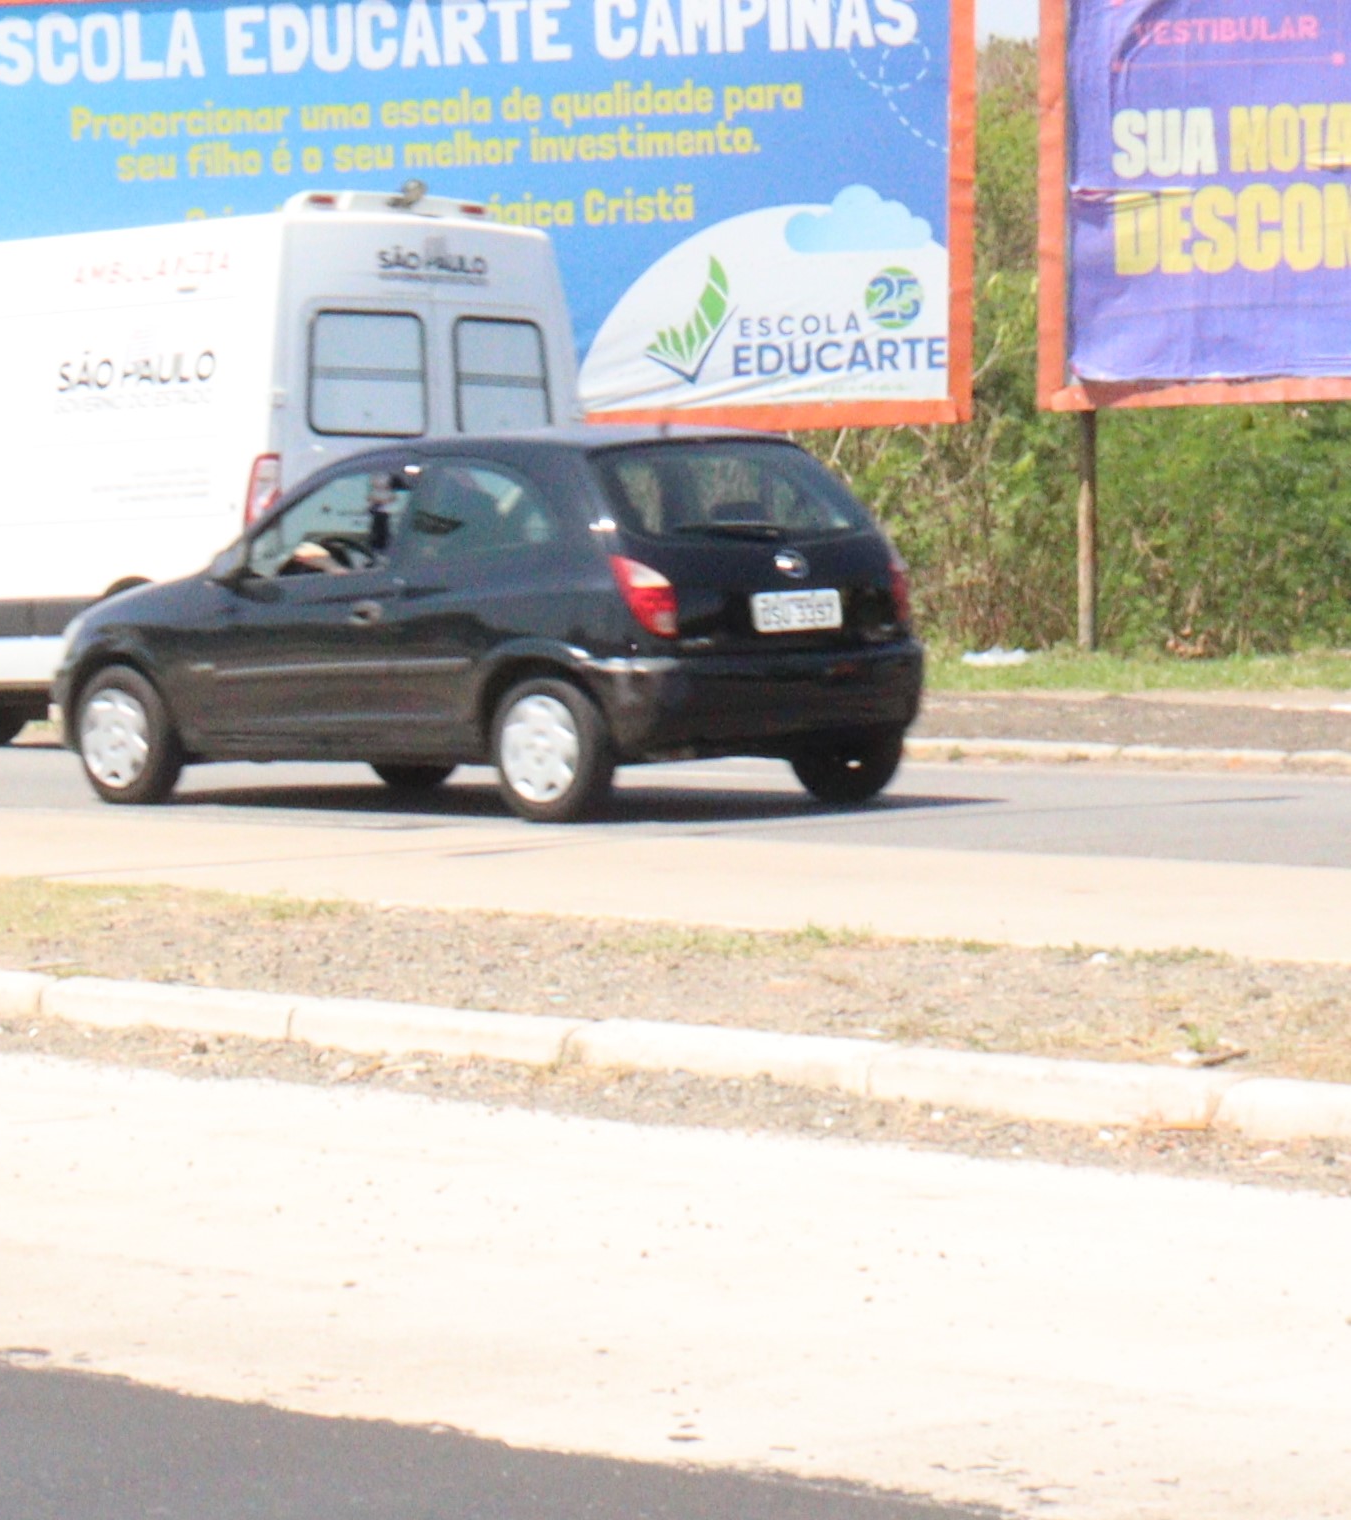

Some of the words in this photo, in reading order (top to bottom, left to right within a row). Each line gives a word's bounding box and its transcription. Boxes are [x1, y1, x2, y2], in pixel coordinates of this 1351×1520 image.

[225, 0, 572, 75] EDUCARTE
[594, 0, 919, 59] CAMPINAS
[71, 100, 291, 147] Proporcionar
[301, 103, 370, 130] uma
[381, 88, 492, 127] escola
[501, 86, 542, 121] de
[551, 80, 715, 127] qualidade
[724, 82, 803, 120] para
[116, 151, 177, 182] seu
[187, 141, 263, 178] filho
[272, 139, 291, 174] é
[302, 148, 322, 173] o
[333, 142, 394, 171] seu
[404, 128, 520, 169] melhor
[530, 121, 761, 163] investimento.
[1112, 107, 1219, 179] SUA
[584, 184, 695, 226] Cristã
[868, 276, 921, 321] 25
[740, 311, 861, 339] ESCOLA
[55, 349, 114, 392] SÃO
[120, 348, 218, 388] PAULO
[732, 336, 947, 378] EDUCARTE
